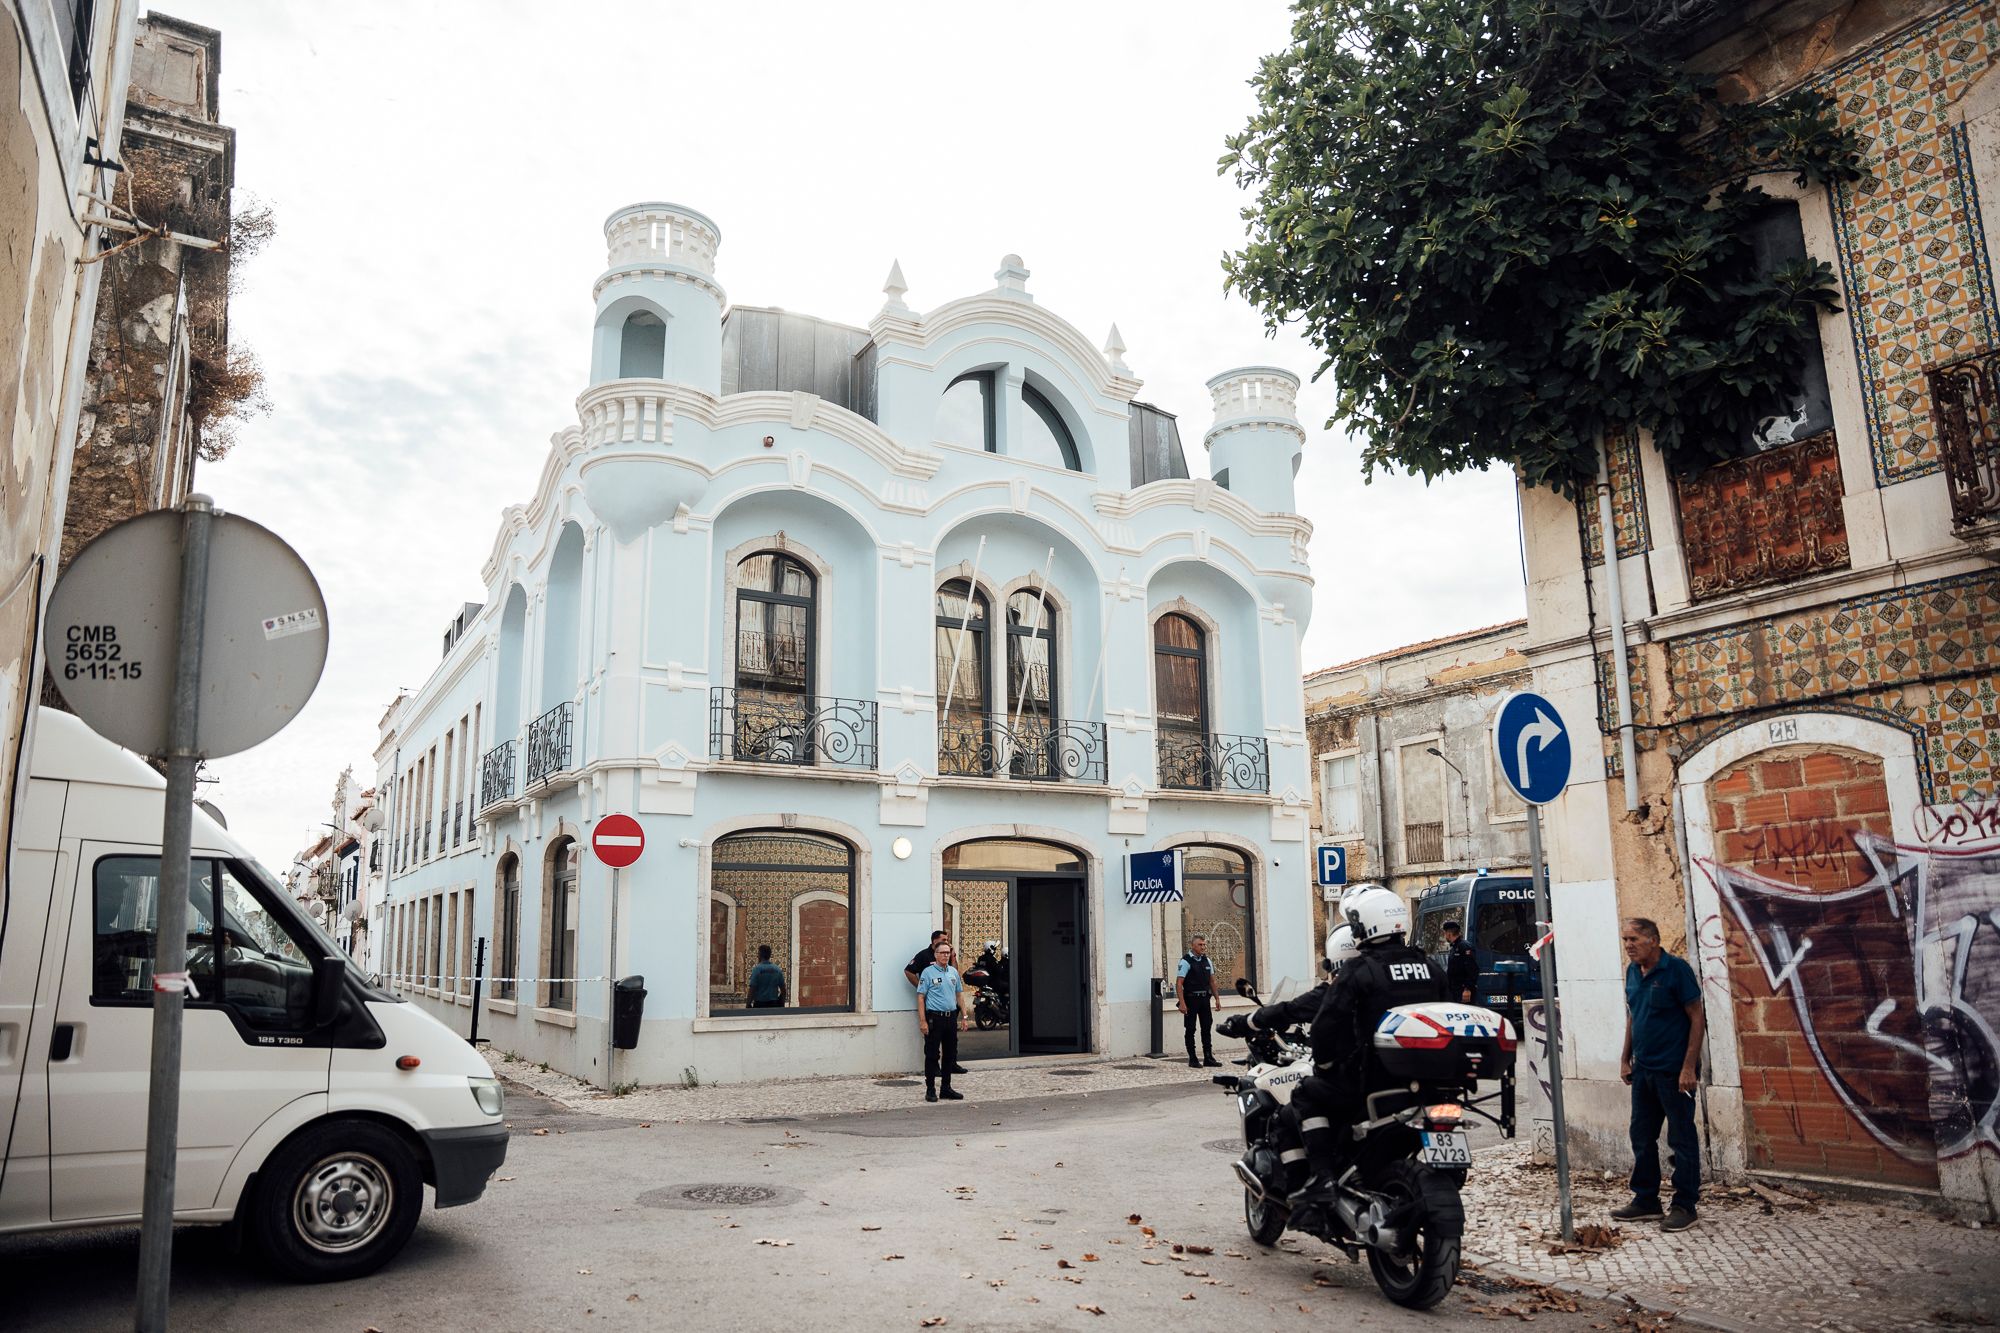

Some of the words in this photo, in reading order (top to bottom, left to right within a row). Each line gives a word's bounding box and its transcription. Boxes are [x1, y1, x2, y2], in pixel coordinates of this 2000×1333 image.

[66, 625, 117, 642] CMB
[65, 643, 121, 661] 5652
[1770, 720, 1796, 742] 213
[1323, 849, 1340, 882] P
[1133, 877, 1163, 890] POLÍCIA
[1389, 963, 1431, 980] EPRI
[1446, 1013, 1470, 1022] PSP
[1269, 1072, 1302, 1087] POLÍCIA
[1436, 1133, 1453, 1147] 83
[1429, 1148, 1467, 1162] ZV23
